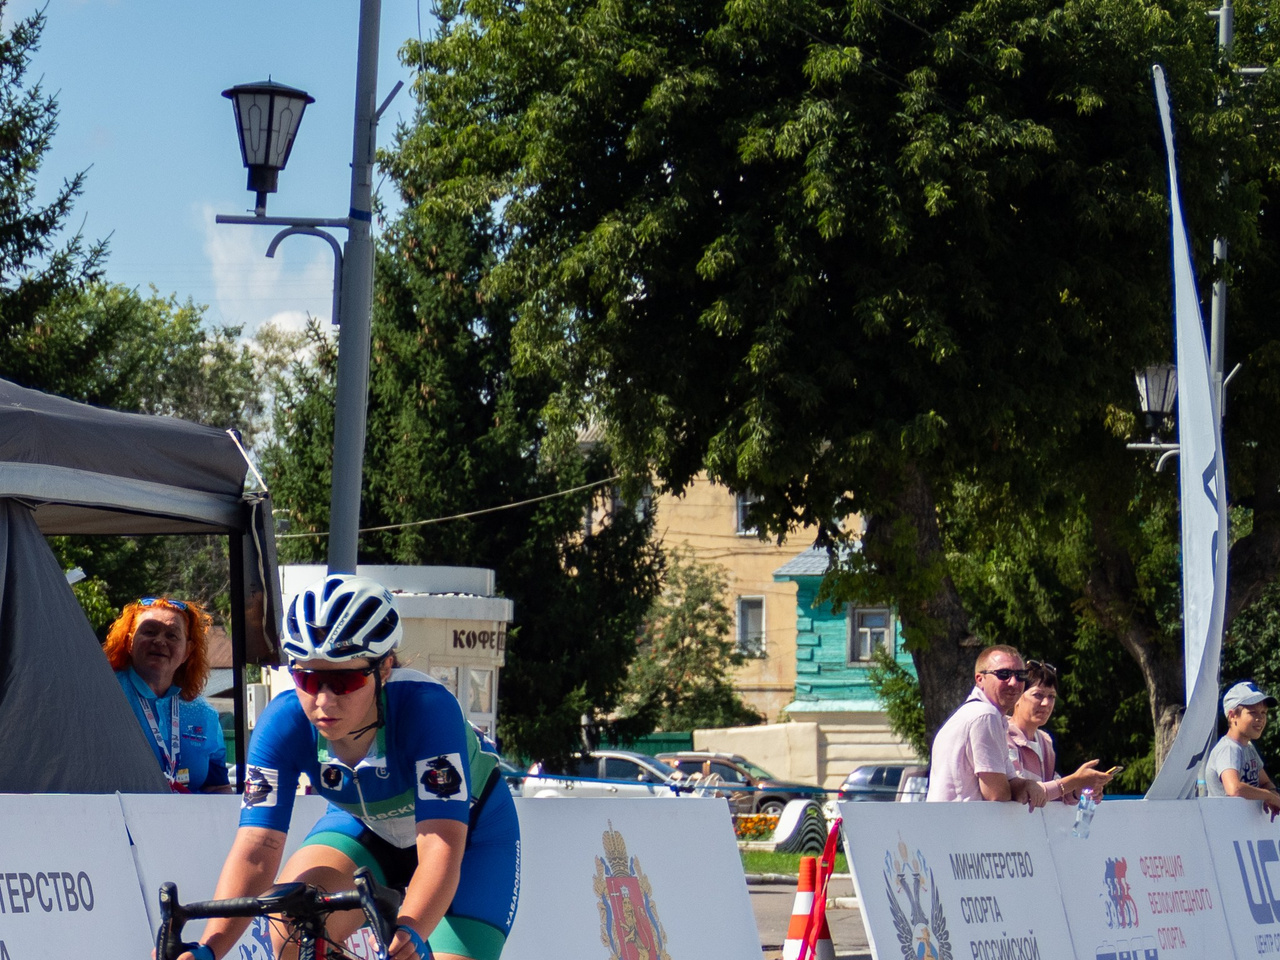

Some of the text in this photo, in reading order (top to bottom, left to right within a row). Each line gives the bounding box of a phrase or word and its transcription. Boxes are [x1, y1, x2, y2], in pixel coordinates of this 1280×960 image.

[452, 628, 497, 650] КОФЕ
[949, 851, 1034, 880] МИНИСТЕРСТВО
[1139, 854, 1185, 883] ФЕДЕРАЦИЯ
[1232, 839, 1280, 925] ЦС
[960, 896, 1004, 924] СПОРТА
[1147, 888, 1213, 916] ВЕЛОСИПЕДНОГО
[1157, 926, 1187, 950] СПОРТА
